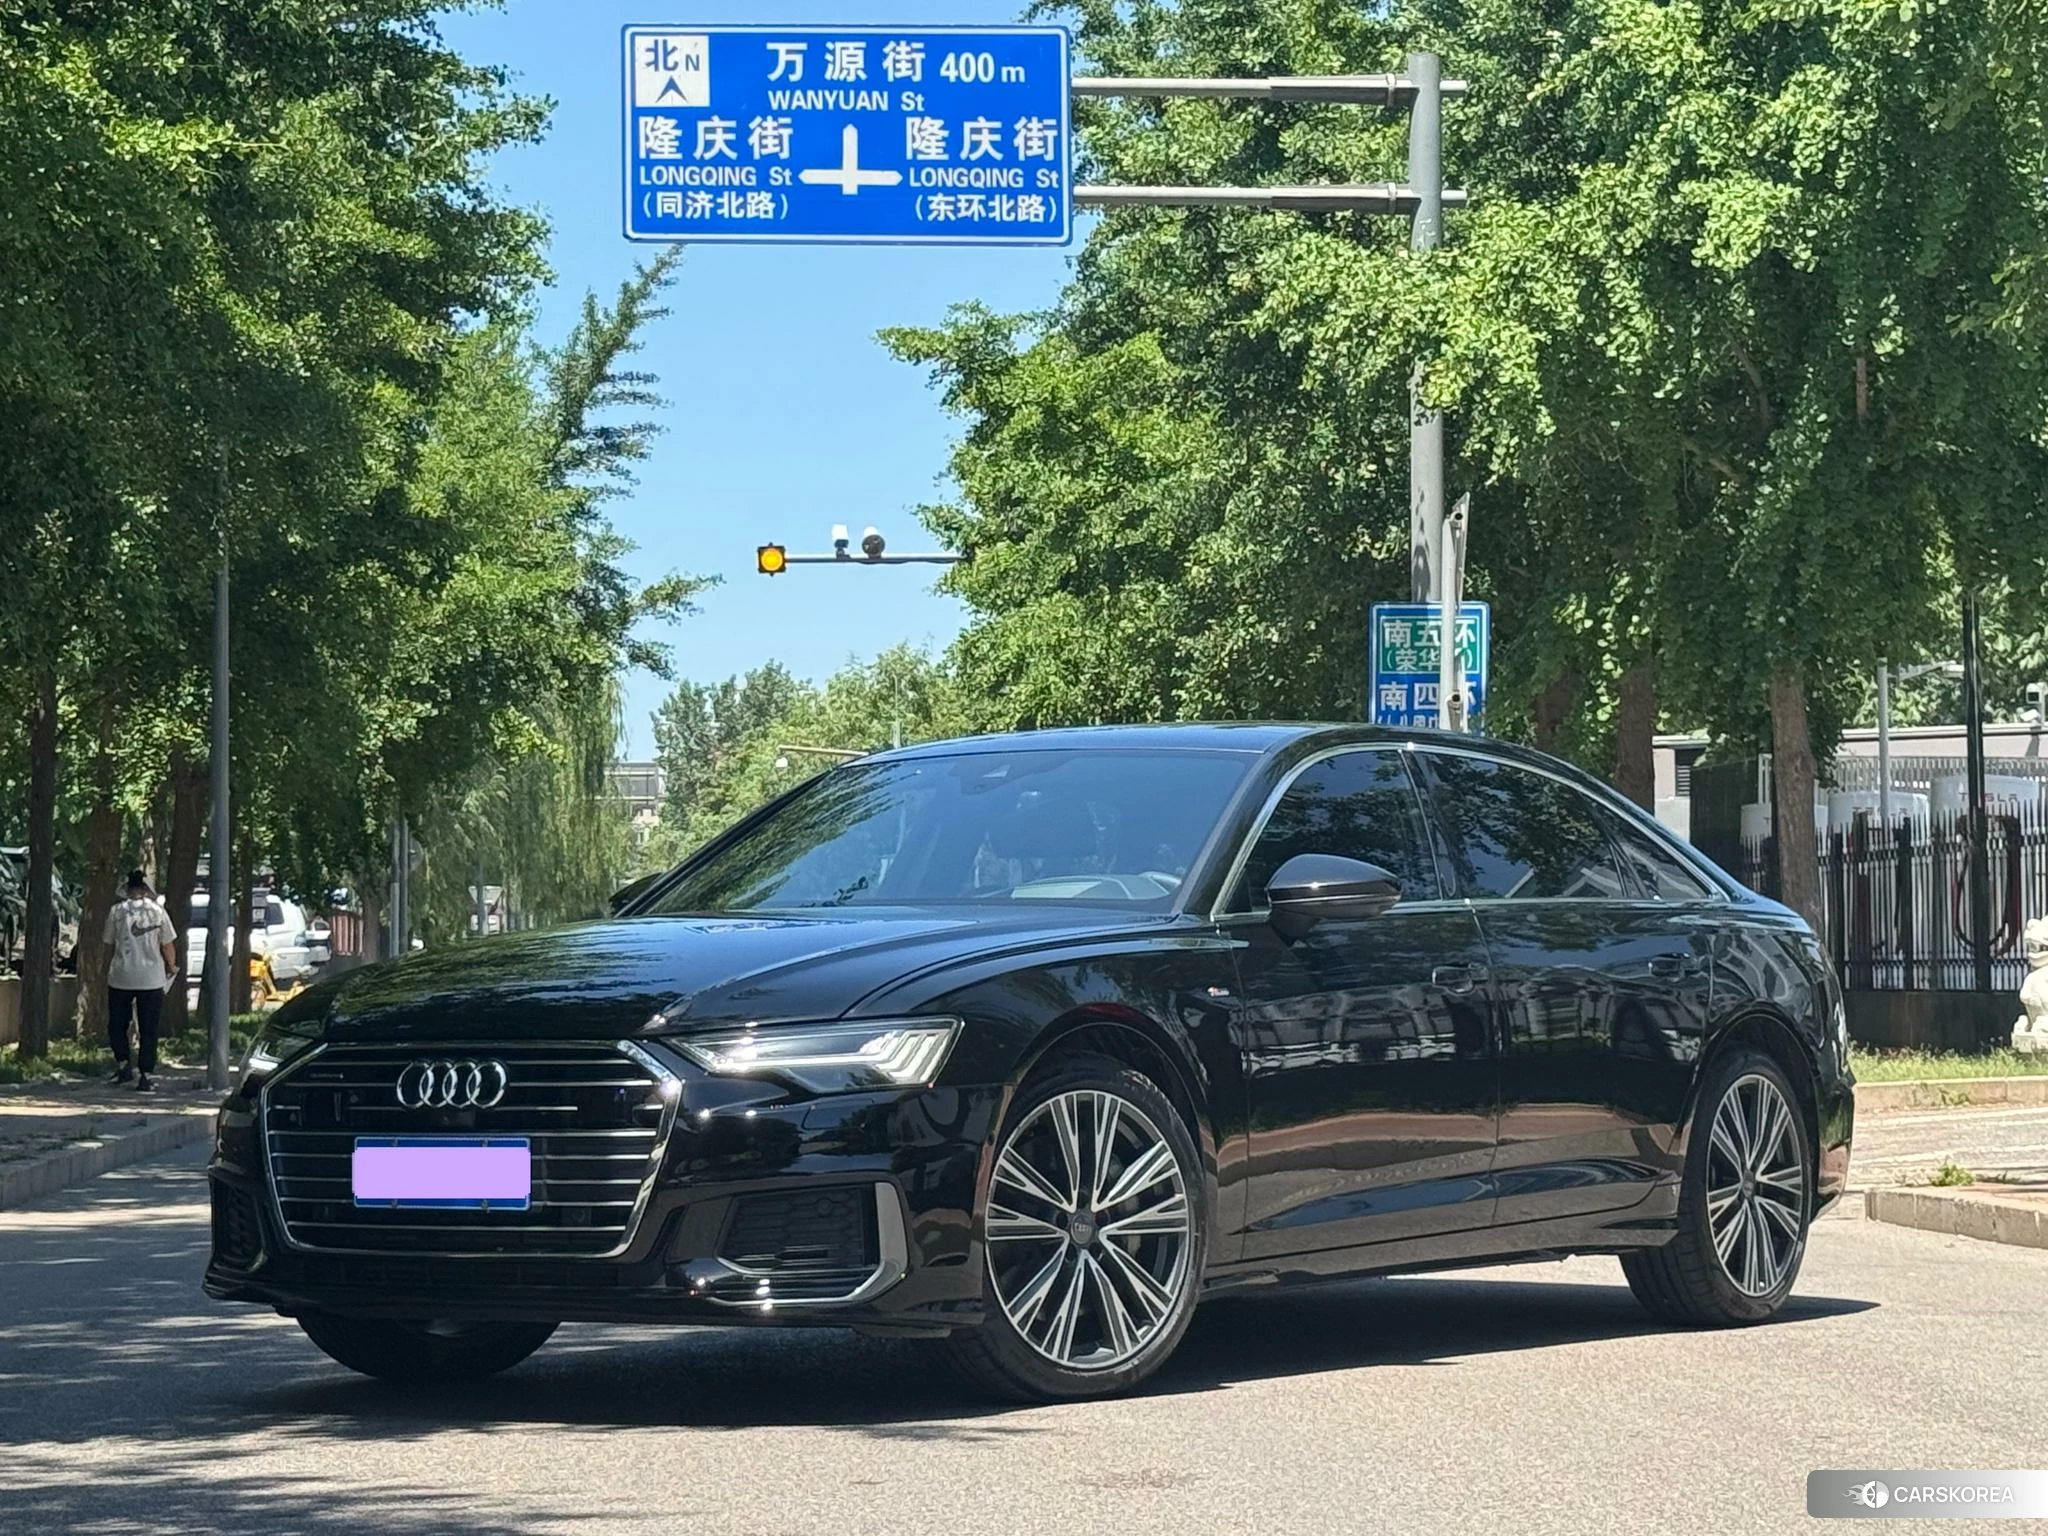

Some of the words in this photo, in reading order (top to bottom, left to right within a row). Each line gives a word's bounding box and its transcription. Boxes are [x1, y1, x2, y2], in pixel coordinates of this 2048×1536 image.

[645, 39, 679, 72] 北
[685, 54, 700, 71] N
[766, 40, 925, 82] 万源街
[939, 52, 995, 83] 400
[1001, 66, 1025, 82] m
[768, 89, 889, 111] WANYUAN
[901, 91, 924, 112] St
[638, 115, 793, 160] 隆庆街
[906, 116, 1058, 161] 隆庆街
[640, 165, 757, 186] LONGQING
[769, 166, 792, 186] St
[909, 167, 1024, 189] LONGQING
[1036, 168, 1059, 188] St
[643, 190, 788, 220] (同济北路)
[915, 192, 1057, 223] (东环北路)
